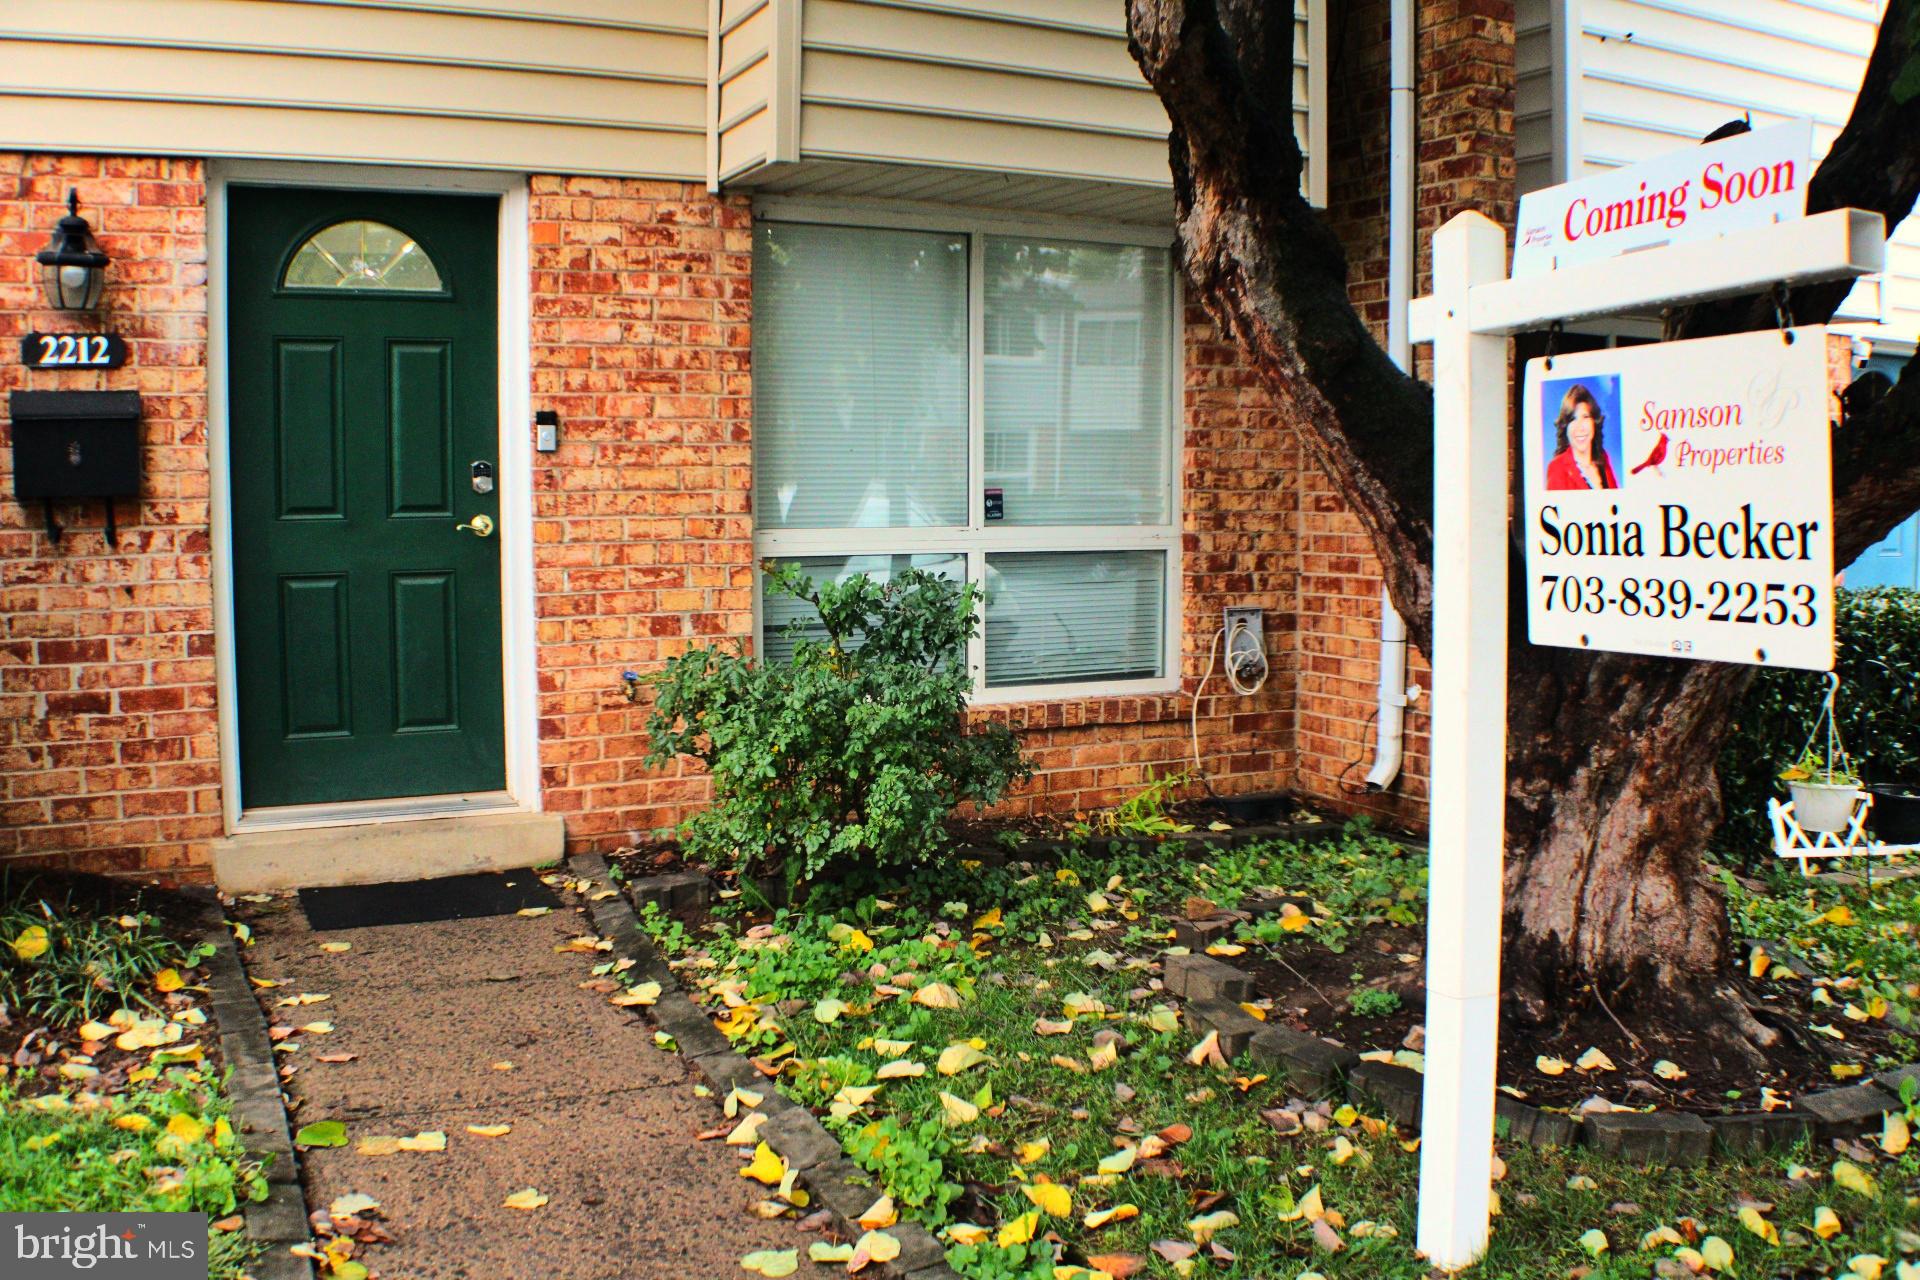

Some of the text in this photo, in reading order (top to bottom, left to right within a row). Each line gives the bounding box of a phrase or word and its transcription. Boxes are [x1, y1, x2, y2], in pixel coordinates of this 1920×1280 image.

[1564, 159, 1795, 241] Coming Soon
[39, 335, 110, 364] 2212
[1639, 400, 1742, 432] Samson
[1675, 439, 1785, 474] Properties
[1540, 503, 1818, 561] Sonia Becker
[1541, 575, 1817, 627] 703-839-2253
